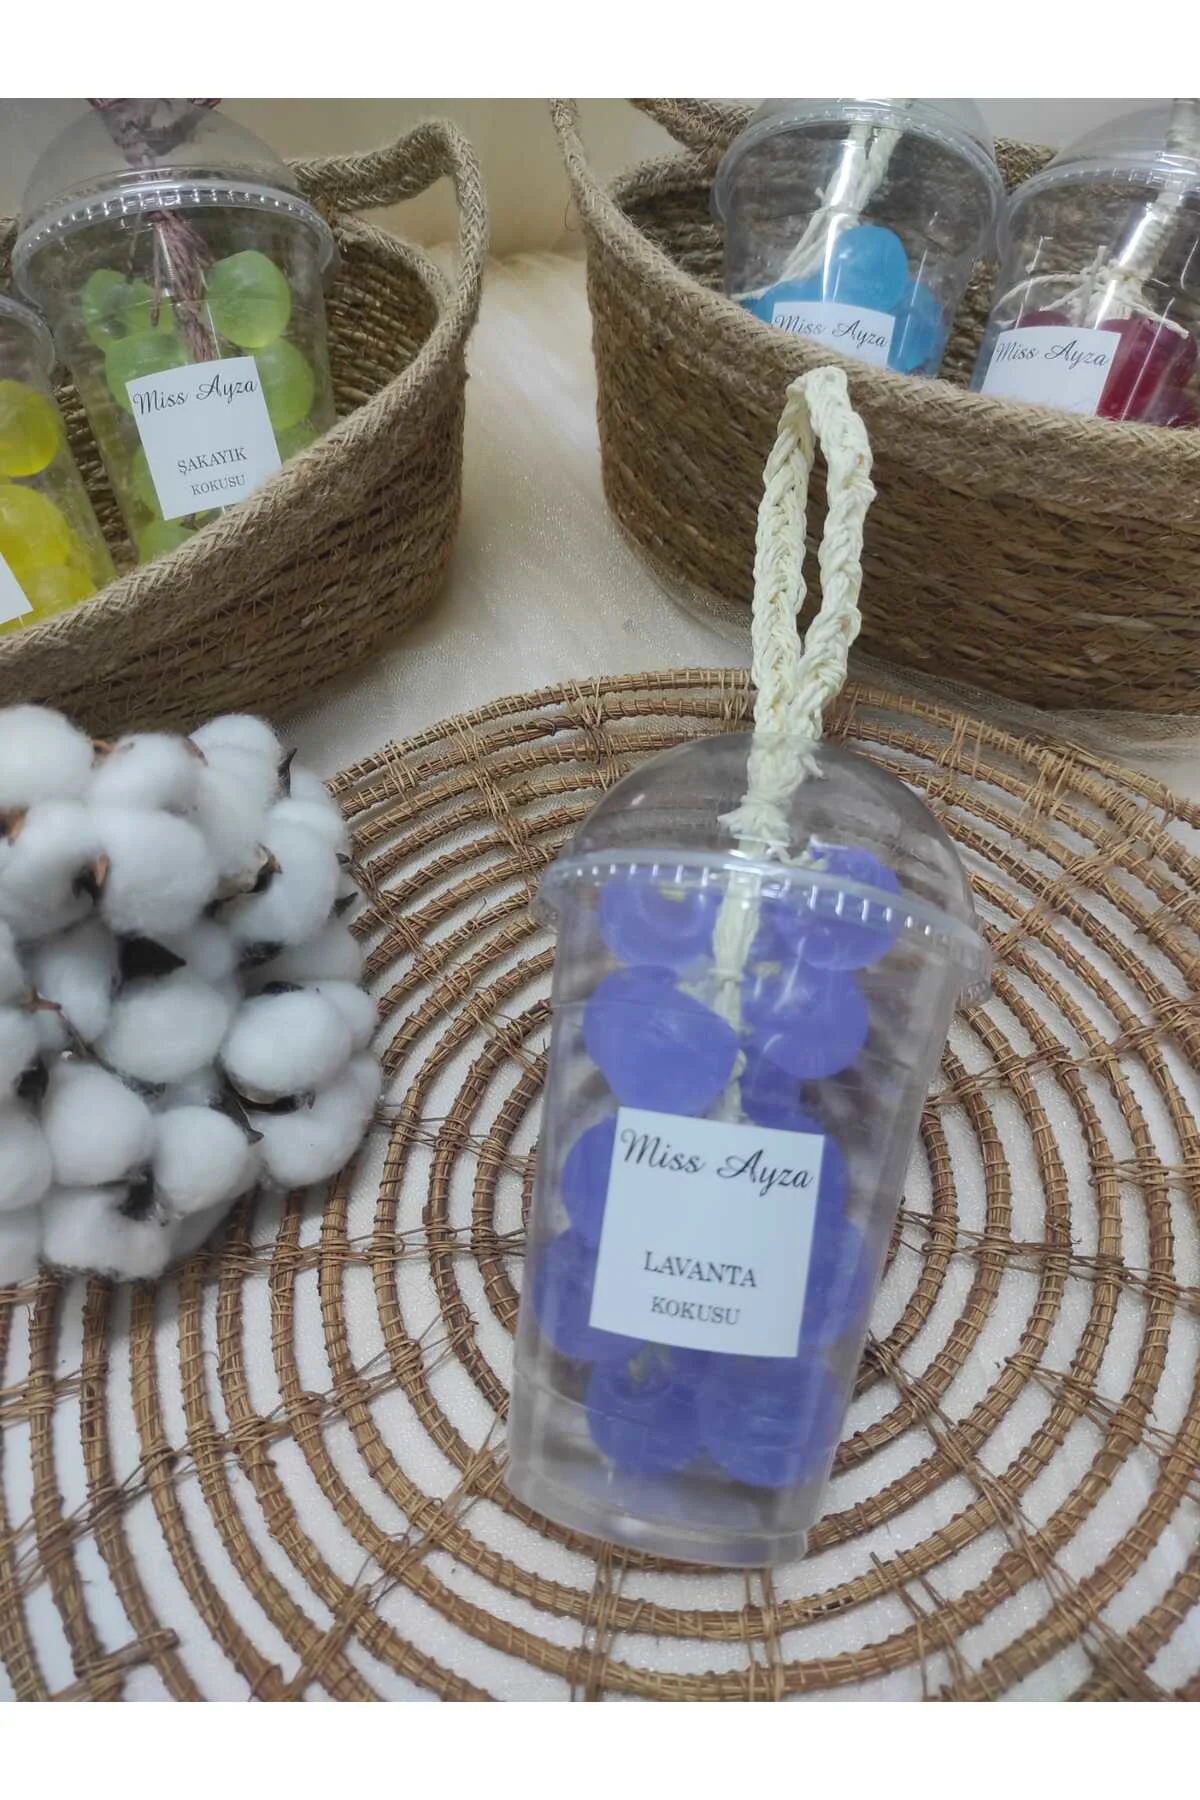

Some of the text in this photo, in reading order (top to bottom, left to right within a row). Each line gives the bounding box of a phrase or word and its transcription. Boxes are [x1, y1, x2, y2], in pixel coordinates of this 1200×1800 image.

[774, 314, 888, 349] Miss Ayza
[996, 340, 1107, 370] Miss Ayza
[133, 374, 257, 414] Miss Ayza
[177, 447, 247, 475] ŞAKAYIK
[191, 474, 246, 495] KOKUSU
[620, 1128, 813, 1197] Miss Ayza
[644, 1250, 757, 1287] LAVANTA
[650, 1296, 741, 1325] KOKUSU
